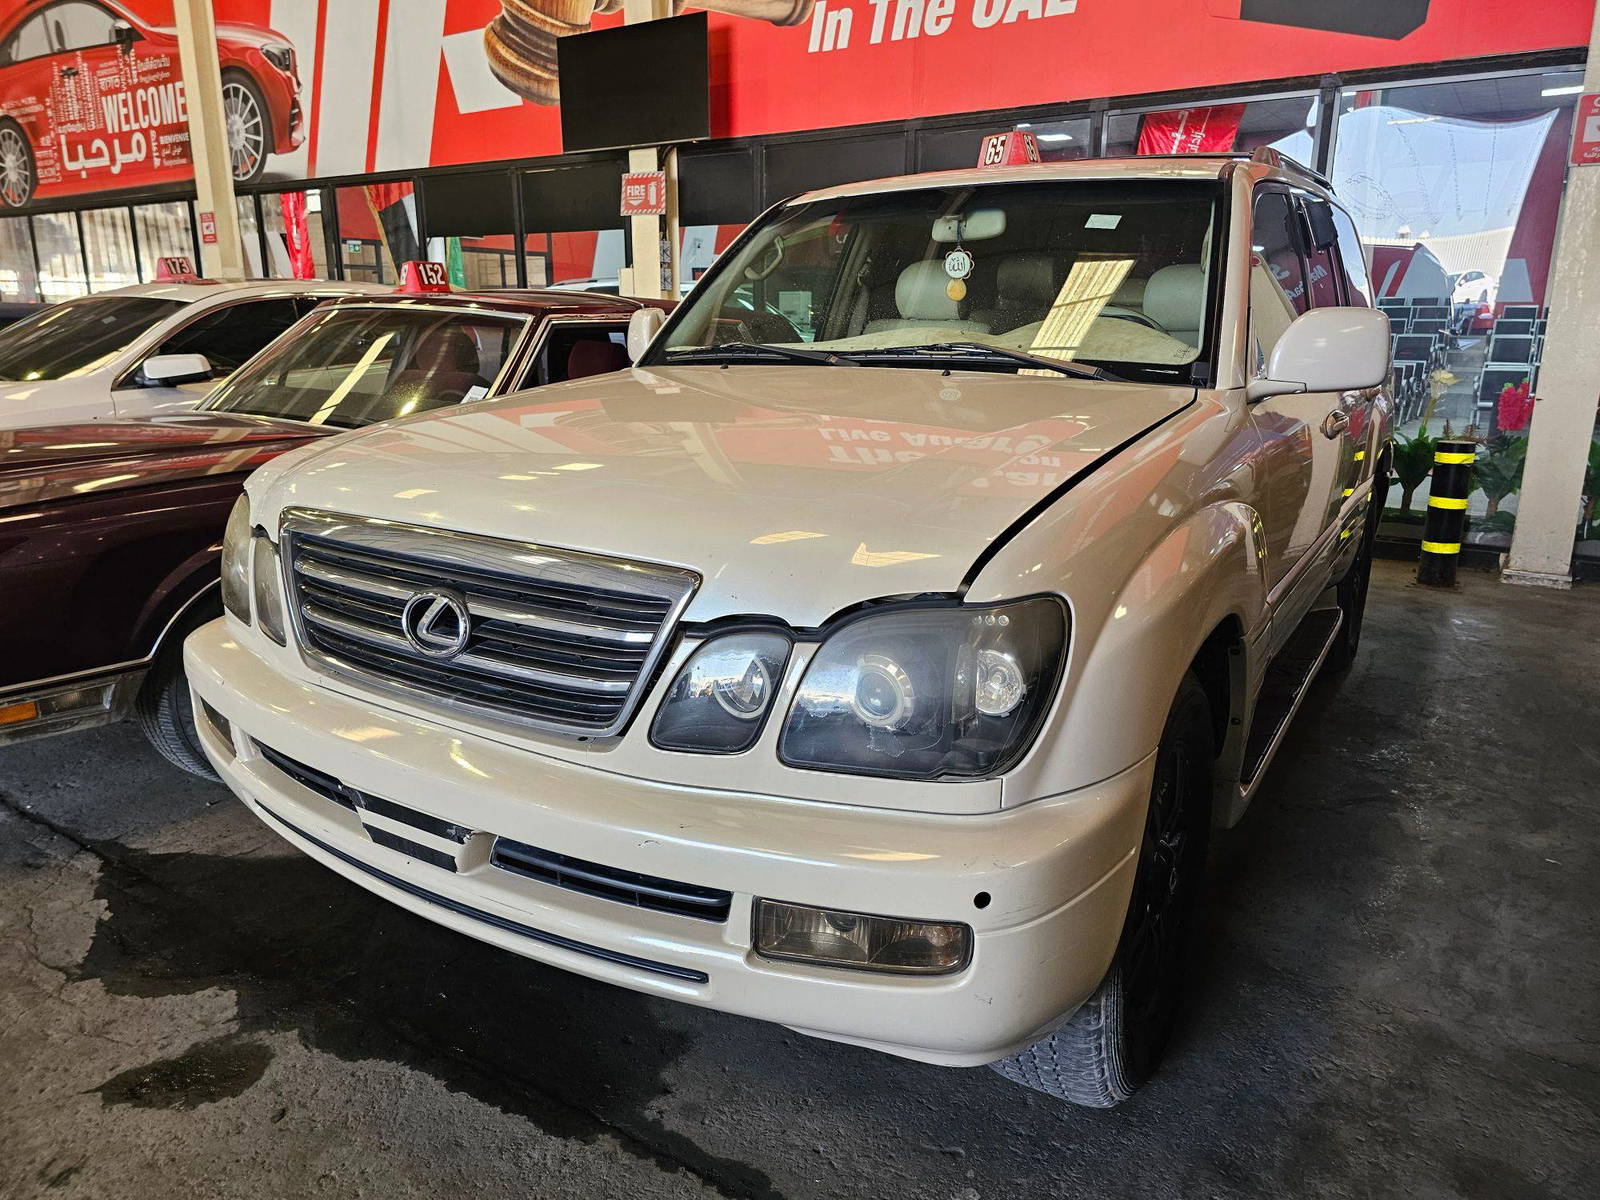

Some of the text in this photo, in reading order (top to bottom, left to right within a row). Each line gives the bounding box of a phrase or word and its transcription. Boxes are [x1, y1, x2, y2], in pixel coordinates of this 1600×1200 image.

[807, 0, 853, 53] In
[867, 0, 956, 45] The
[101, 81, 189, 133] WELCOME
[61, 131, 147, 179] مرحبا
[985, 135, 1007, 165] 65
[626, 184, 646, 197] FIRE
[166, 258, 191, 275] 173
[418, 263, 446, 285] 152
